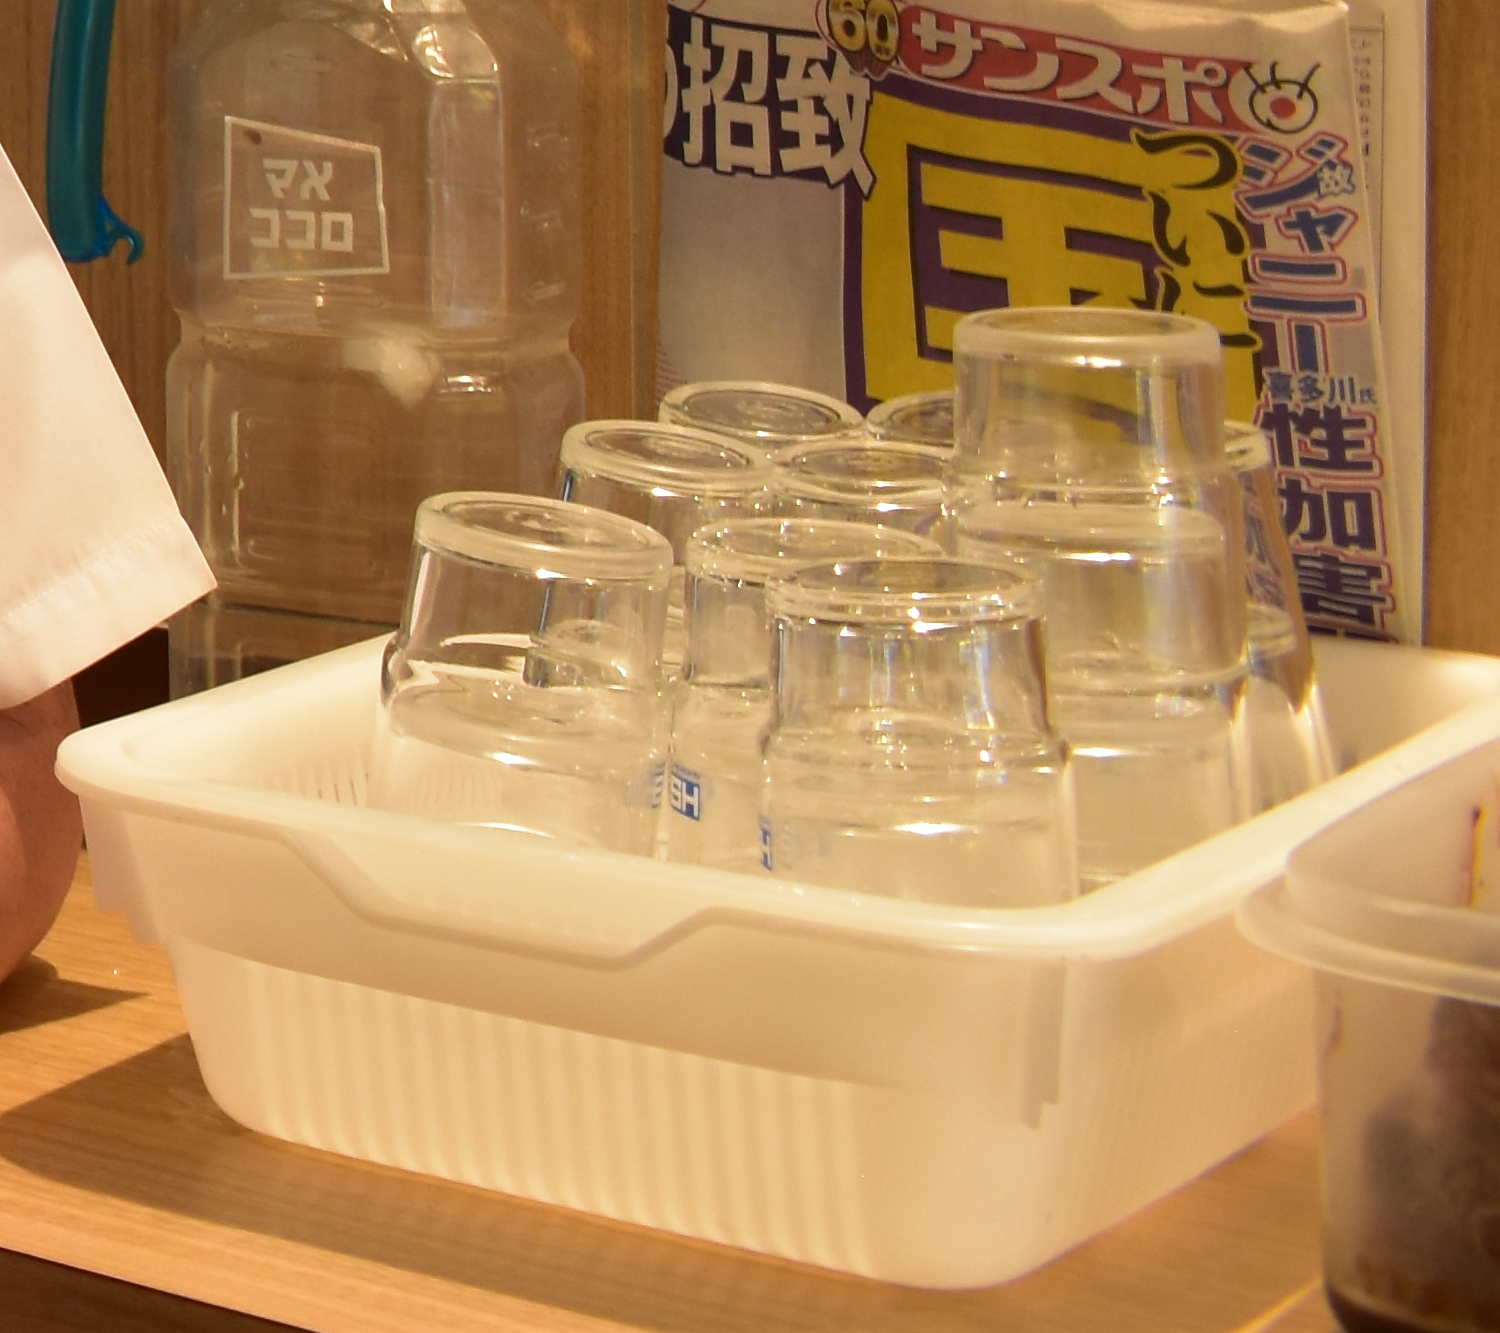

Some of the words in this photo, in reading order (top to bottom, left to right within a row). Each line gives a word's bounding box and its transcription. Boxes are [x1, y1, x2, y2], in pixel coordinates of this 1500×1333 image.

[911, 9, 1229, 124] サンスポ
[1260, 401, 1390, 644] 性加害
